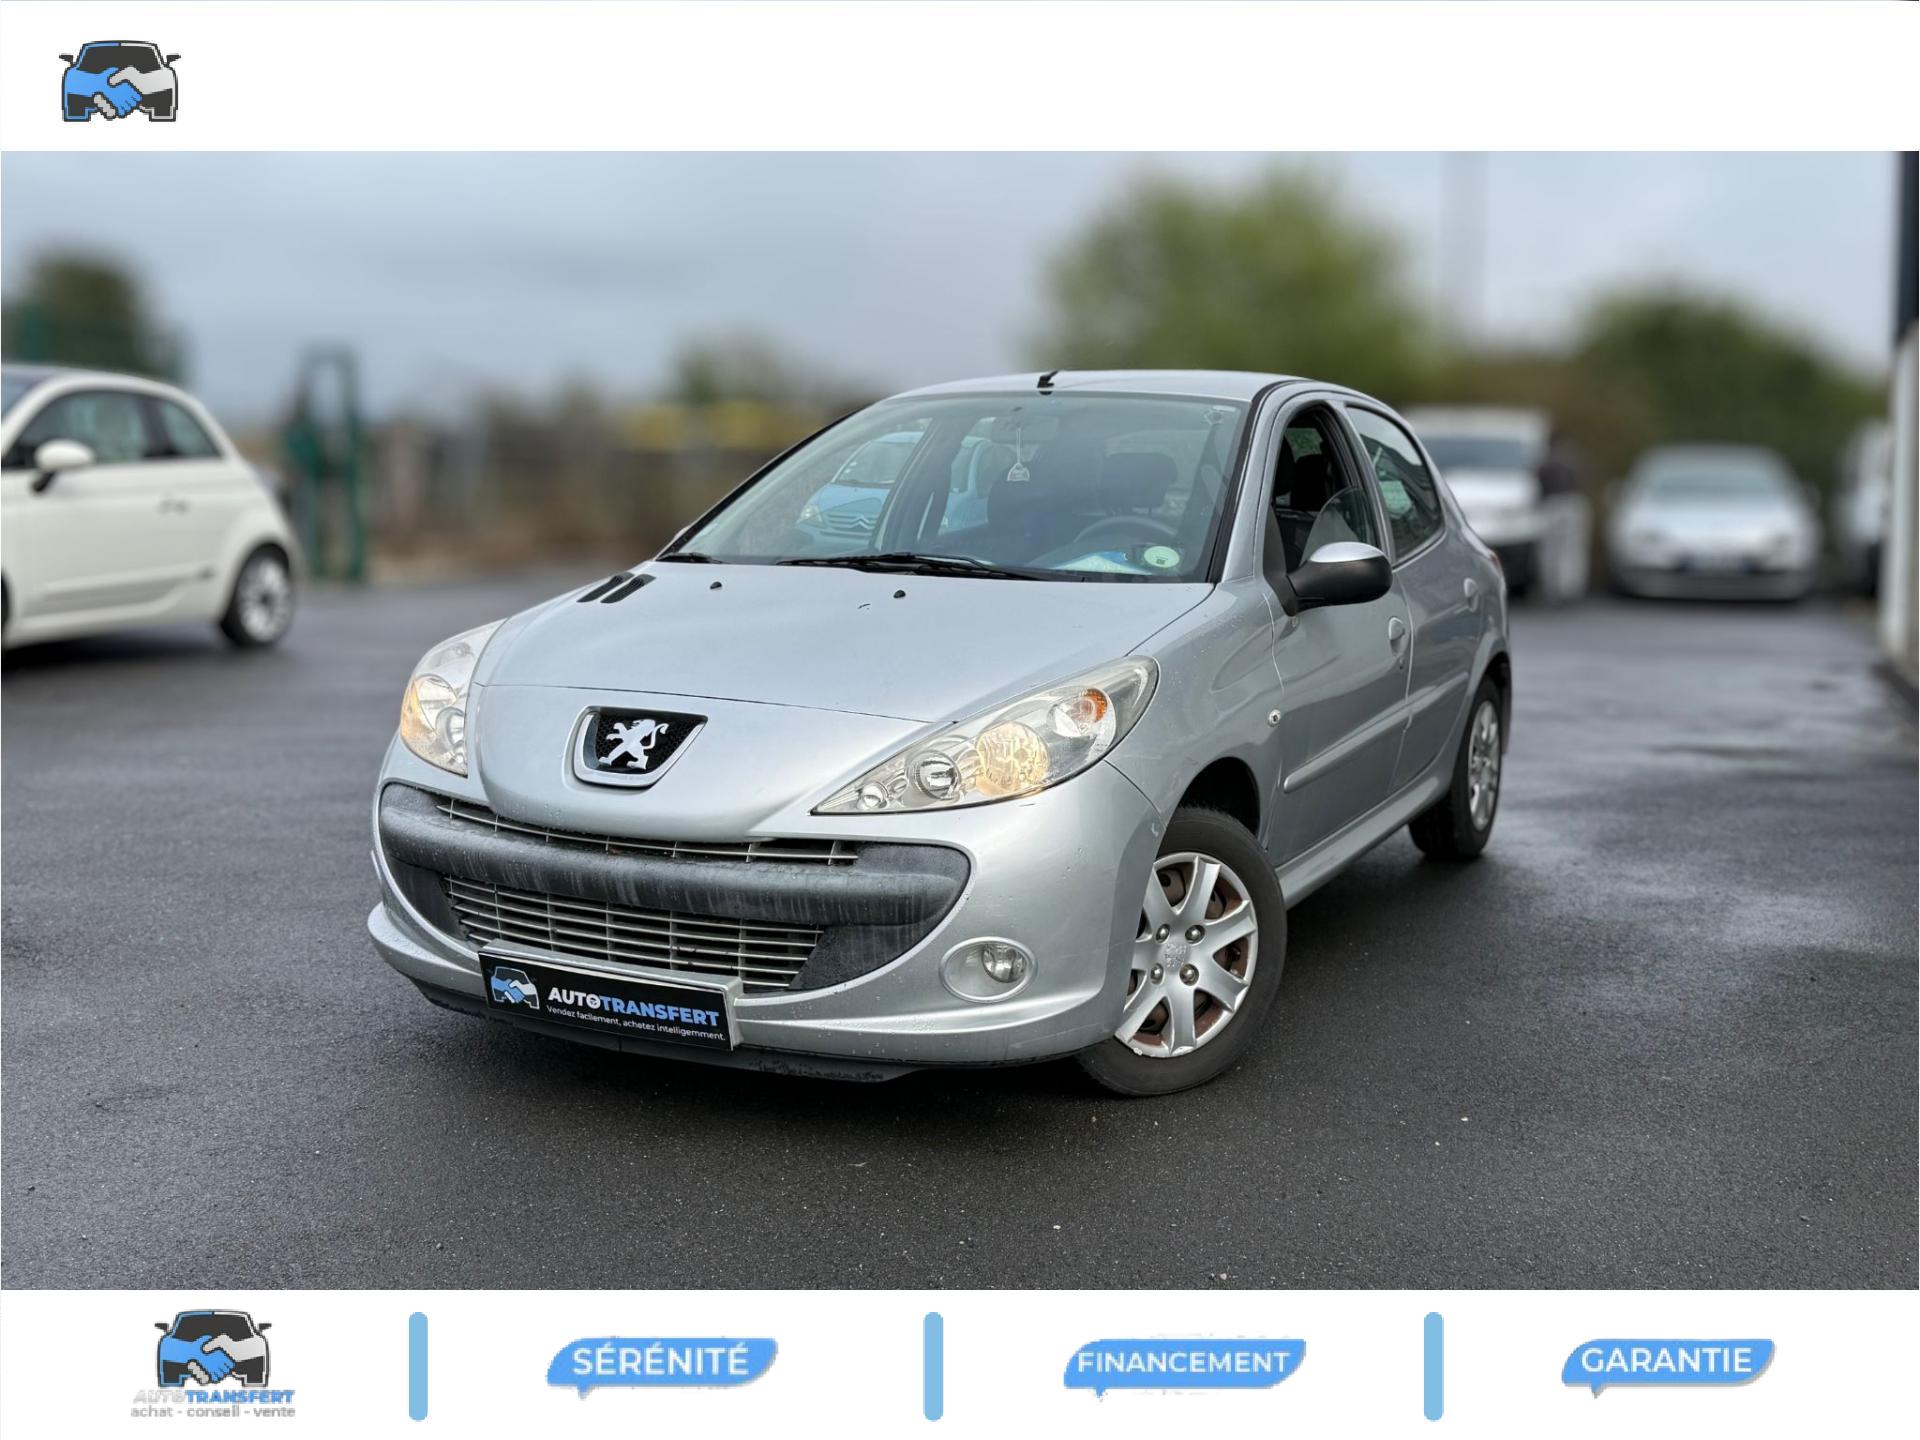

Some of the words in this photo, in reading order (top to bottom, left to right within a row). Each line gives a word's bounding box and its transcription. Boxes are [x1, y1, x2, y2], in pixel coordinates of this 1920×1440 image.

[546, 1005, 576, 1017] Vendez
[576, 1010, 621, 1026] facilement,
[623, 1020, 656, 1031] achetez
[548, 987, 719, 1026] AUTOTRANSFERT
